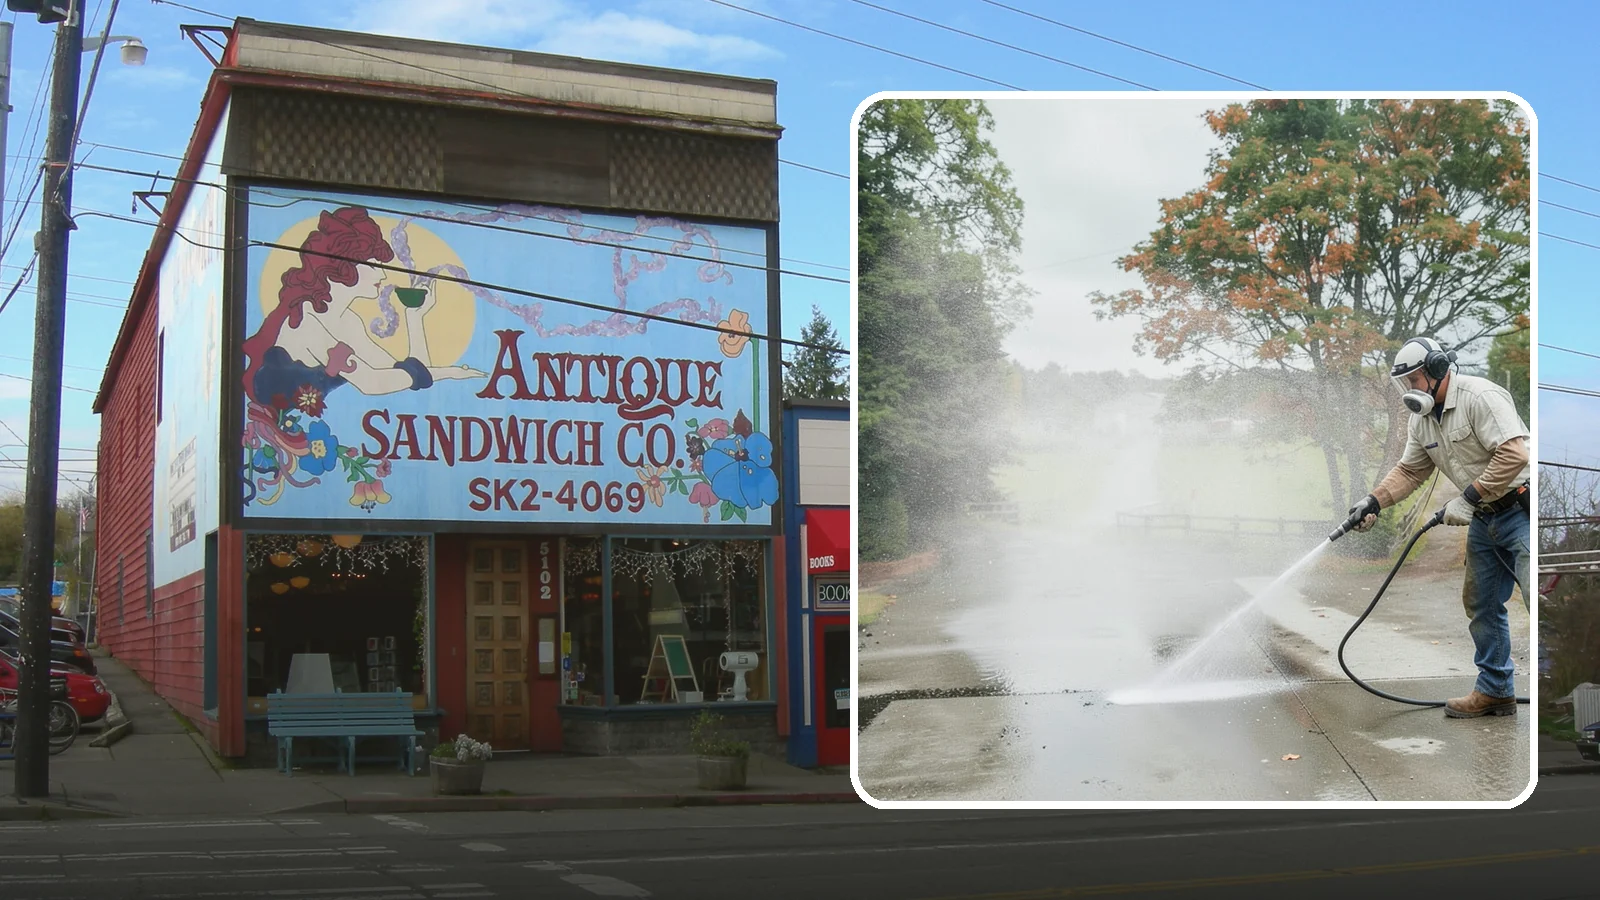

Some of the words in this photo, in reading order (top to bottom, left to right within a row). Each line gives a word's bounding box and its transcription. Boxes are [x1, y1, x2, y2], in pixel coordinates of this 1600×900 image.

[476, 329, 723, 421] ANTIQUE
[361, 408, 604, 467] SANDWICH
[617, 422, 685, 468] CO.
[468, 476, 646, 513] SK2-4069
[540, 541, 551, 600] 5102
[809, 555, 835, 569] BOOKS
